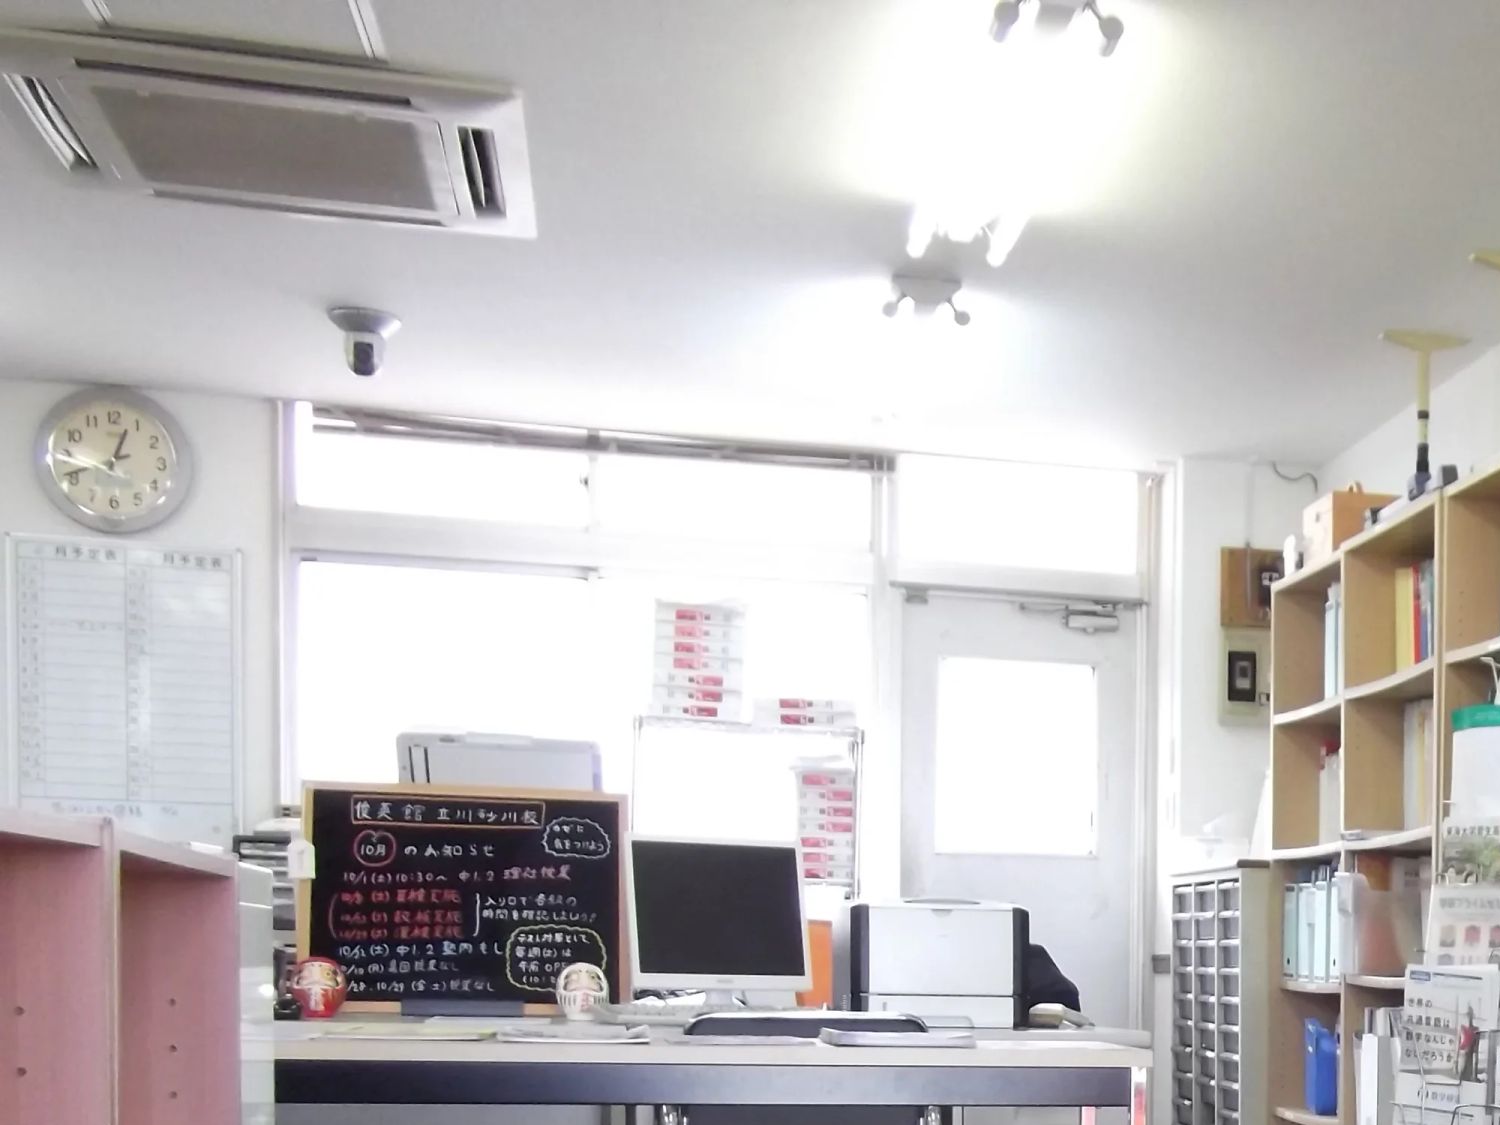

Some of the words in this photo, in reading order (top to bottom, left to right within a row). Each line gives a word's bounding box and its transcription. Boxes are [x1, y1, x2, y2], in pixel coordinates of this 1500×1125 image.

[86, 414, 98, 429] 11
[106, 410, 121, 425] 12
[134, 418, 140, 432] 1
[67, 428, 82, 443] 10
[149, 435, 159, 449] 2
[156, 456, 167, 472] 3
[149, 479, 158, 491] 4
[109, 495, 120, 509] 6
[133, 492, 143, 506] 5
[361, 844, 386, 857] 10月
